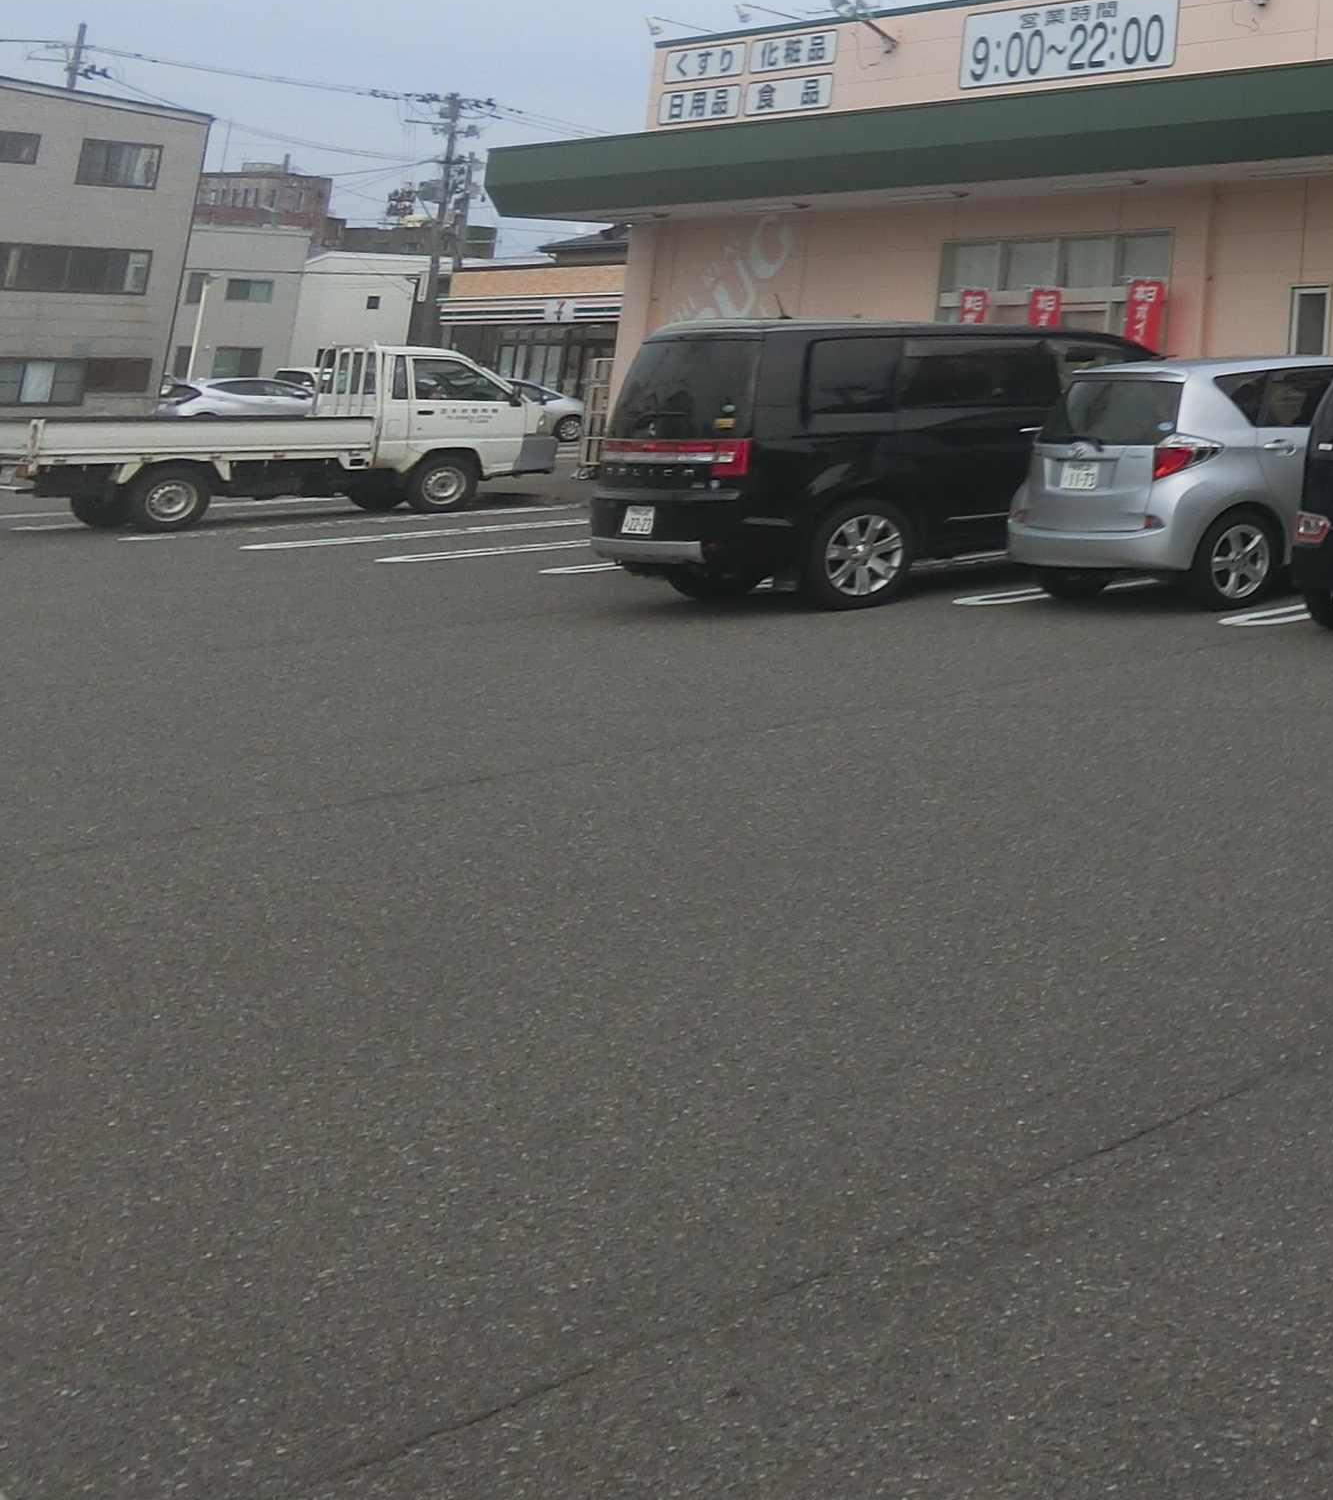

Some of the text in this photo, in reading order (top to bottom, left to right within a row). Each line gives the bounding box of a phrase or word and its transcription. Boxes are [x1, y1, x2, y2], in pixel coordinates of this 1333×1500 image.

[1019, 1, 1118, 29] 営業時間
[676, 47, 734, 77] くすり
[759, 35, 826, 68] 化粧品
[668, 89, 728, 120] 日用品
